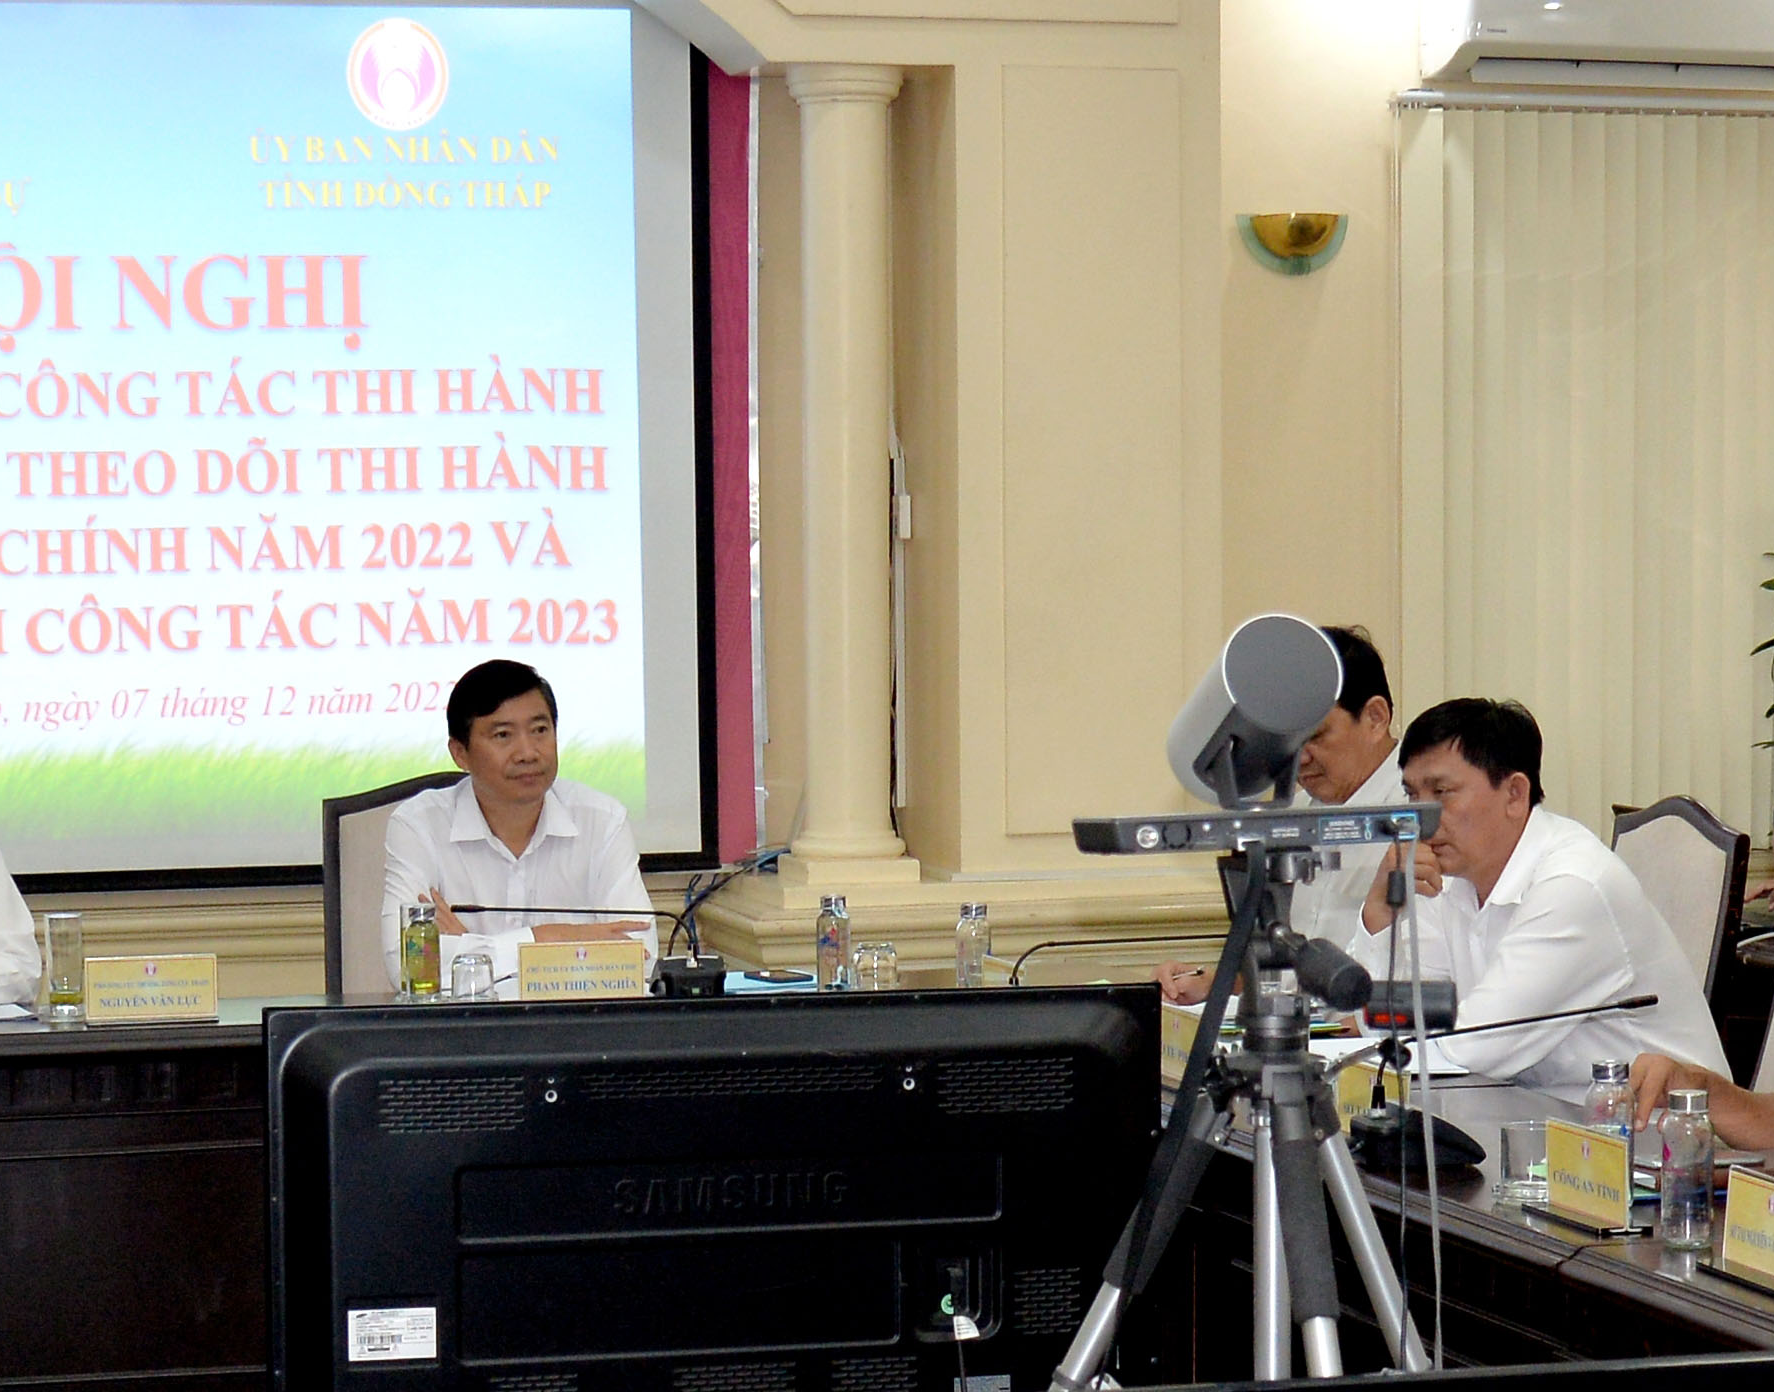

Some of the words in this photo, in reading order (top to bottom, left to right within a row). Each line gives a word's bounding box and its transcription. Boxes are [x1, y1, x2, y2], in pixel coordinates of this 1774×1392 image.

[248, 127, 296, 163] ỦY
[304, 135, 373, 163] BAN
[384, 128, 478, 163] NHÂN
[490, 129, 560, 163] DÂN
[260, 171, 344, 208] TỈNH
[353, 174, 452, 208] ĐỒNG
[461, 173, 552, 208] THÁP
[109, 253, 369, 352] NGHỊ
[175, 355, 296, 417] TÁC
[312, 368, 417, 415] THI
[433, 353, 605, 414] HÀNH
[6, 450, 177, 498] THEO
[193, 436, 302, 495] DÕI
[317, 446, 423, 493] THI
[439, 430, 610, 492] HÀNH
[207, 511, 346, 571] NĂM
[361, 521, 475, 569] 2022
[490, 507, 573, 567] VÀ
[25, 592, 202, 655] CÔNG
[216, 589, 338, 649] TÁC
[354, 586, 492, 648] NĂM
[505, 597, 620, 645] 2023
[22, 691, 101, 729] ngày
[110, 688, 150, 720] 07
[159, 685, 249, 726] tháng
[261, 685, 296, 716] 12
[307, 689, 373, 715] năm
[614, 1171, 848, 1214] SAMSUNG
